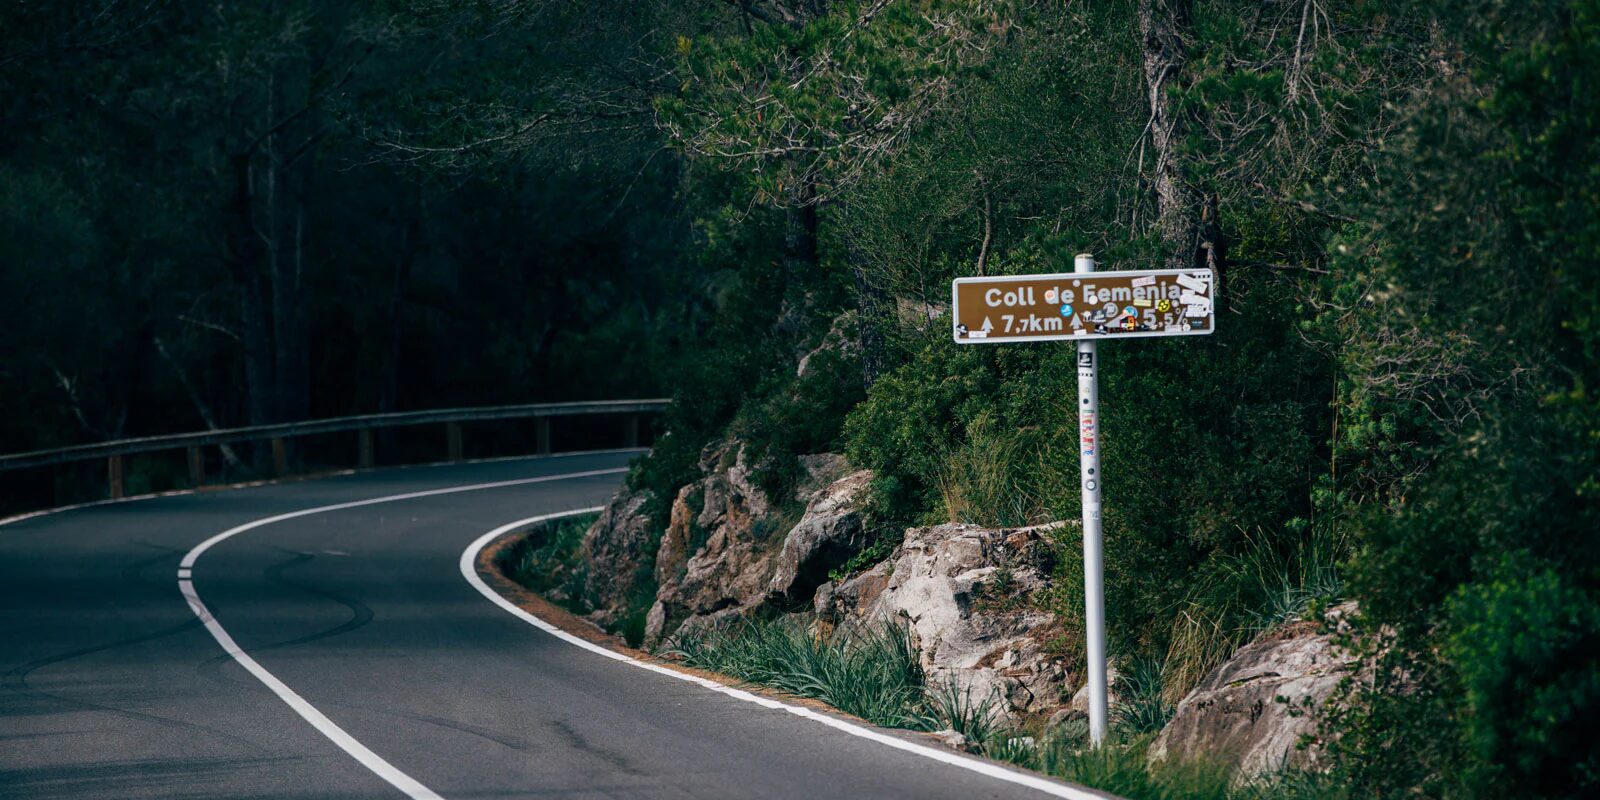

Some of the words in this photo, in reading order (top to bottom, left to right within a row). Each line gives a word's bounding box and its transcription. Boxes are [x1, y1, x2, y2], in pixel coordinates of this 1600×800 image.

[985, 286, 1036, 307] Coll
[1044, 286, 1075, 305] de
[1083, 281, 1181, 303] Femenia
